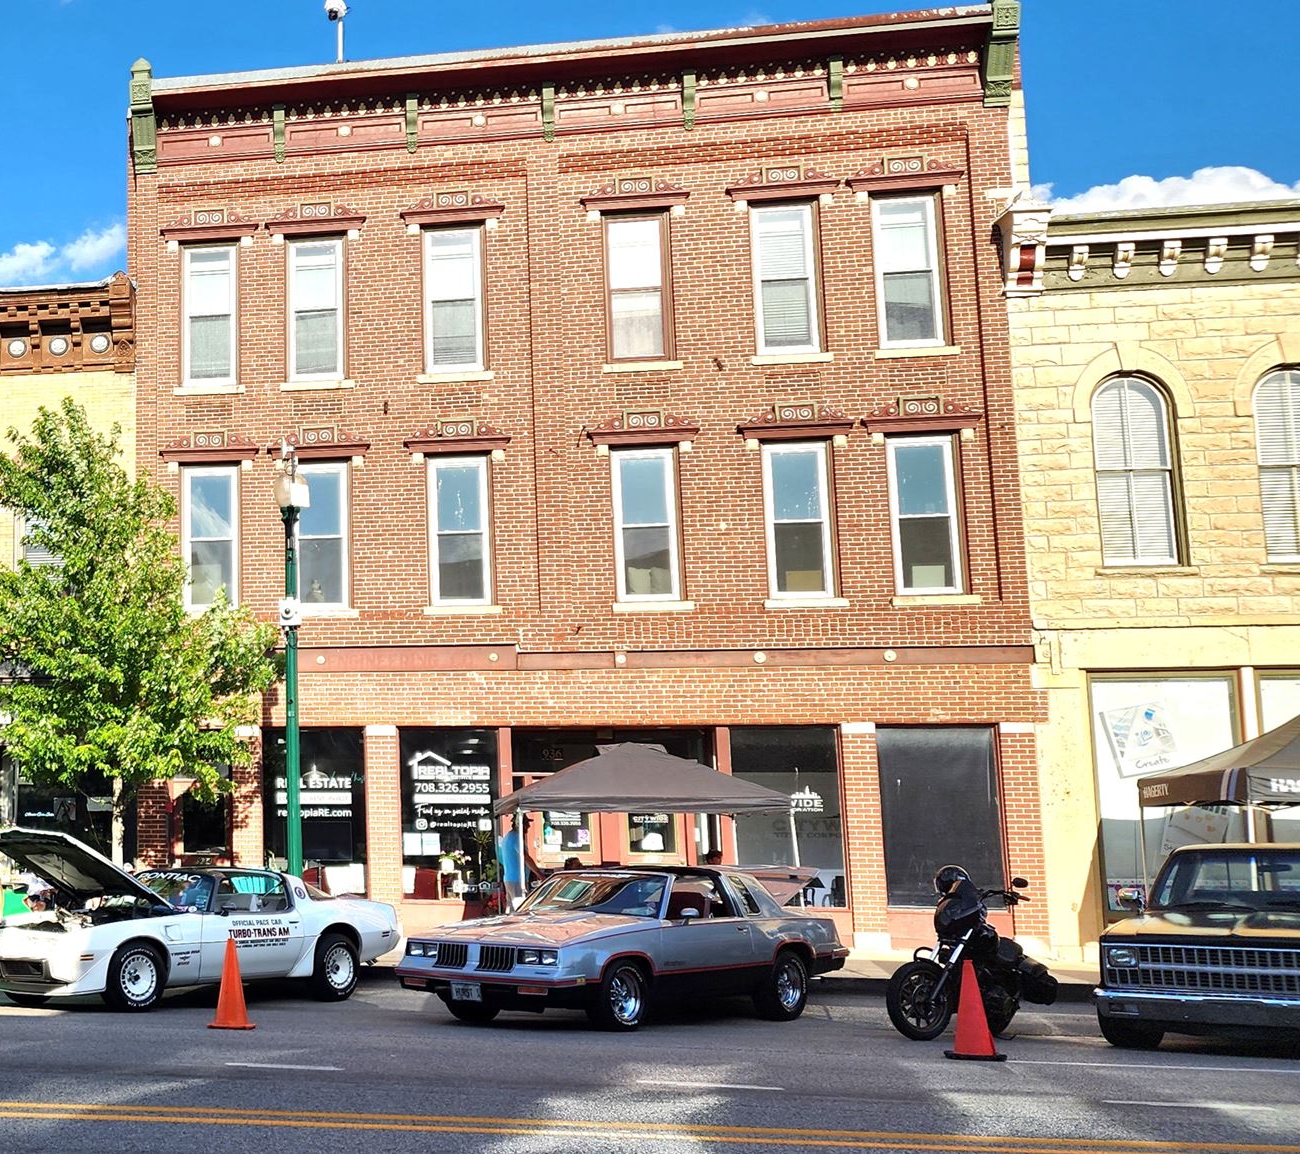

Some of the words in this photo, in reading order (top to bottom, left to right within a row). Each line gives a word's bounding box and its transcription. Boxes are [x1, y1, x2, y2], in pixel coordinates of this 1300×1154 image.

[1135, 755, 1171, 769] Create
[276, 777, 306, 789] RL
[309, 777, 352, 789] ESTATE
[414, 782, 490, 793] 708.326.2955
[1270, 778, 1300, 792] HA
[1143, 783, 1169, 799] HAGERTY
[277, 808, 352, 819] reopiaRE.com
[414, 803, 433, 817] Find
[136, 872, 201, 883] PONTIAC
[228, 928, 277, 939] TURBO-TRANS
[278, 927, 290, 936] AM
